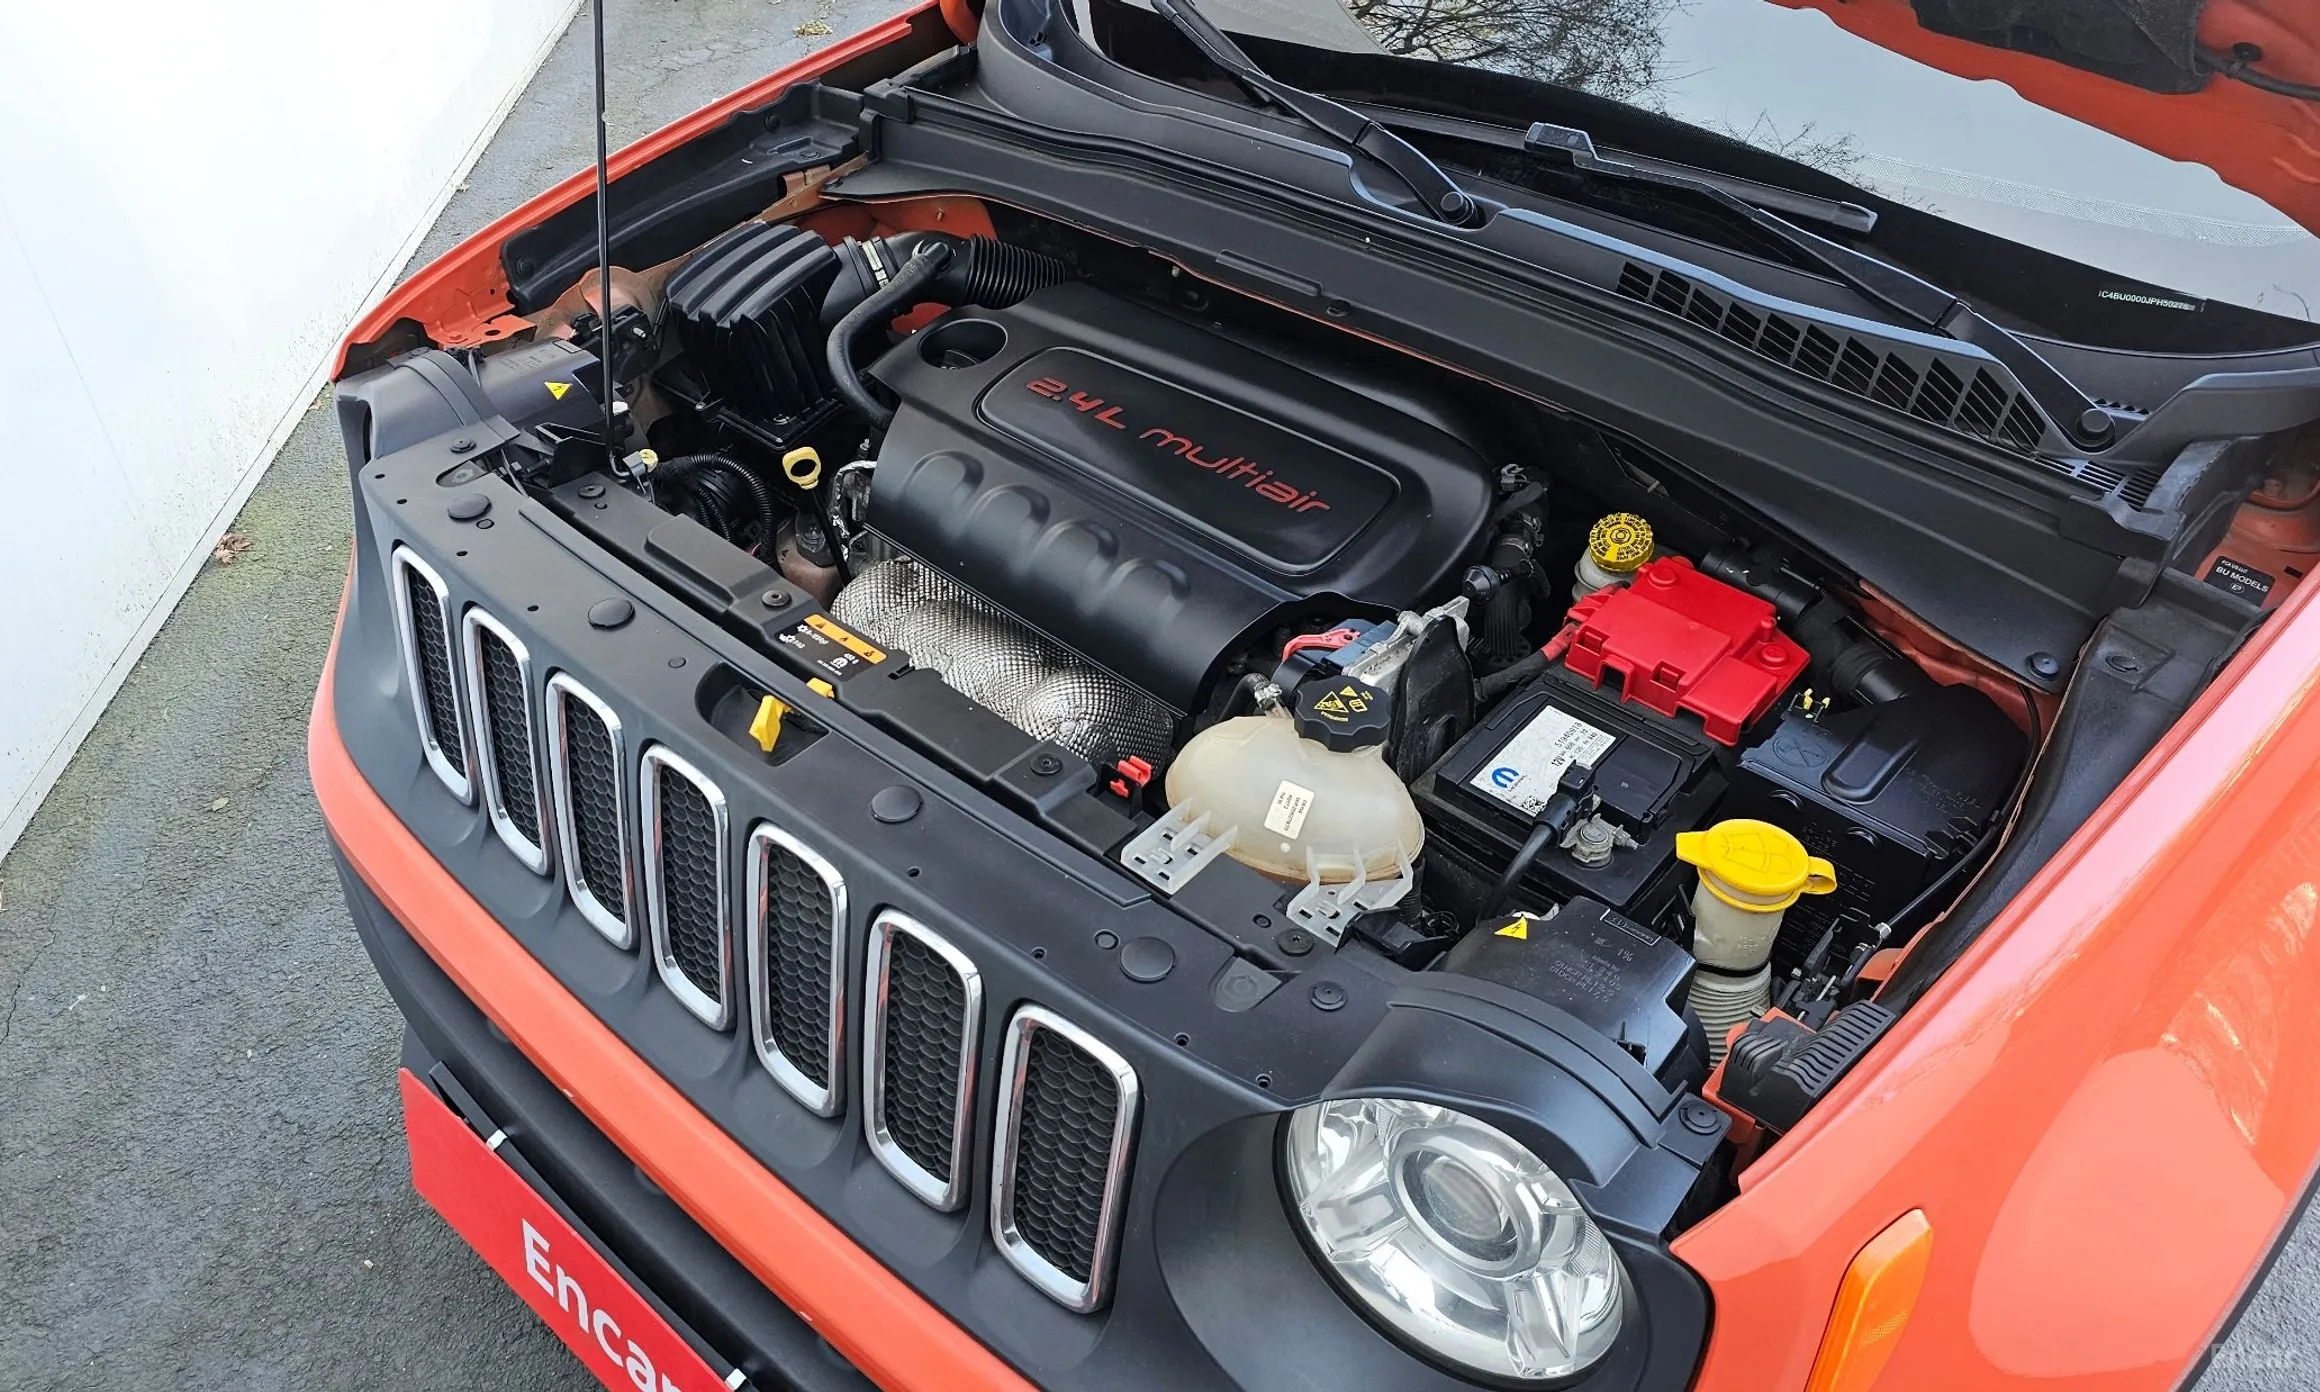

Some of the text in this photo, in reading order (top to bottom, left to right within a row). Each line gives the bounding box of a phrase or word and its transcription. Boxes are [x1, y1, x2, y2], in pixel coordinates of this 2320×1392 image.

[1026, 377, 1331, 513] 2.4L multiair
[2215, 566, 2230, 576] BU
[2230, 572, 2269, 592] MODELS
